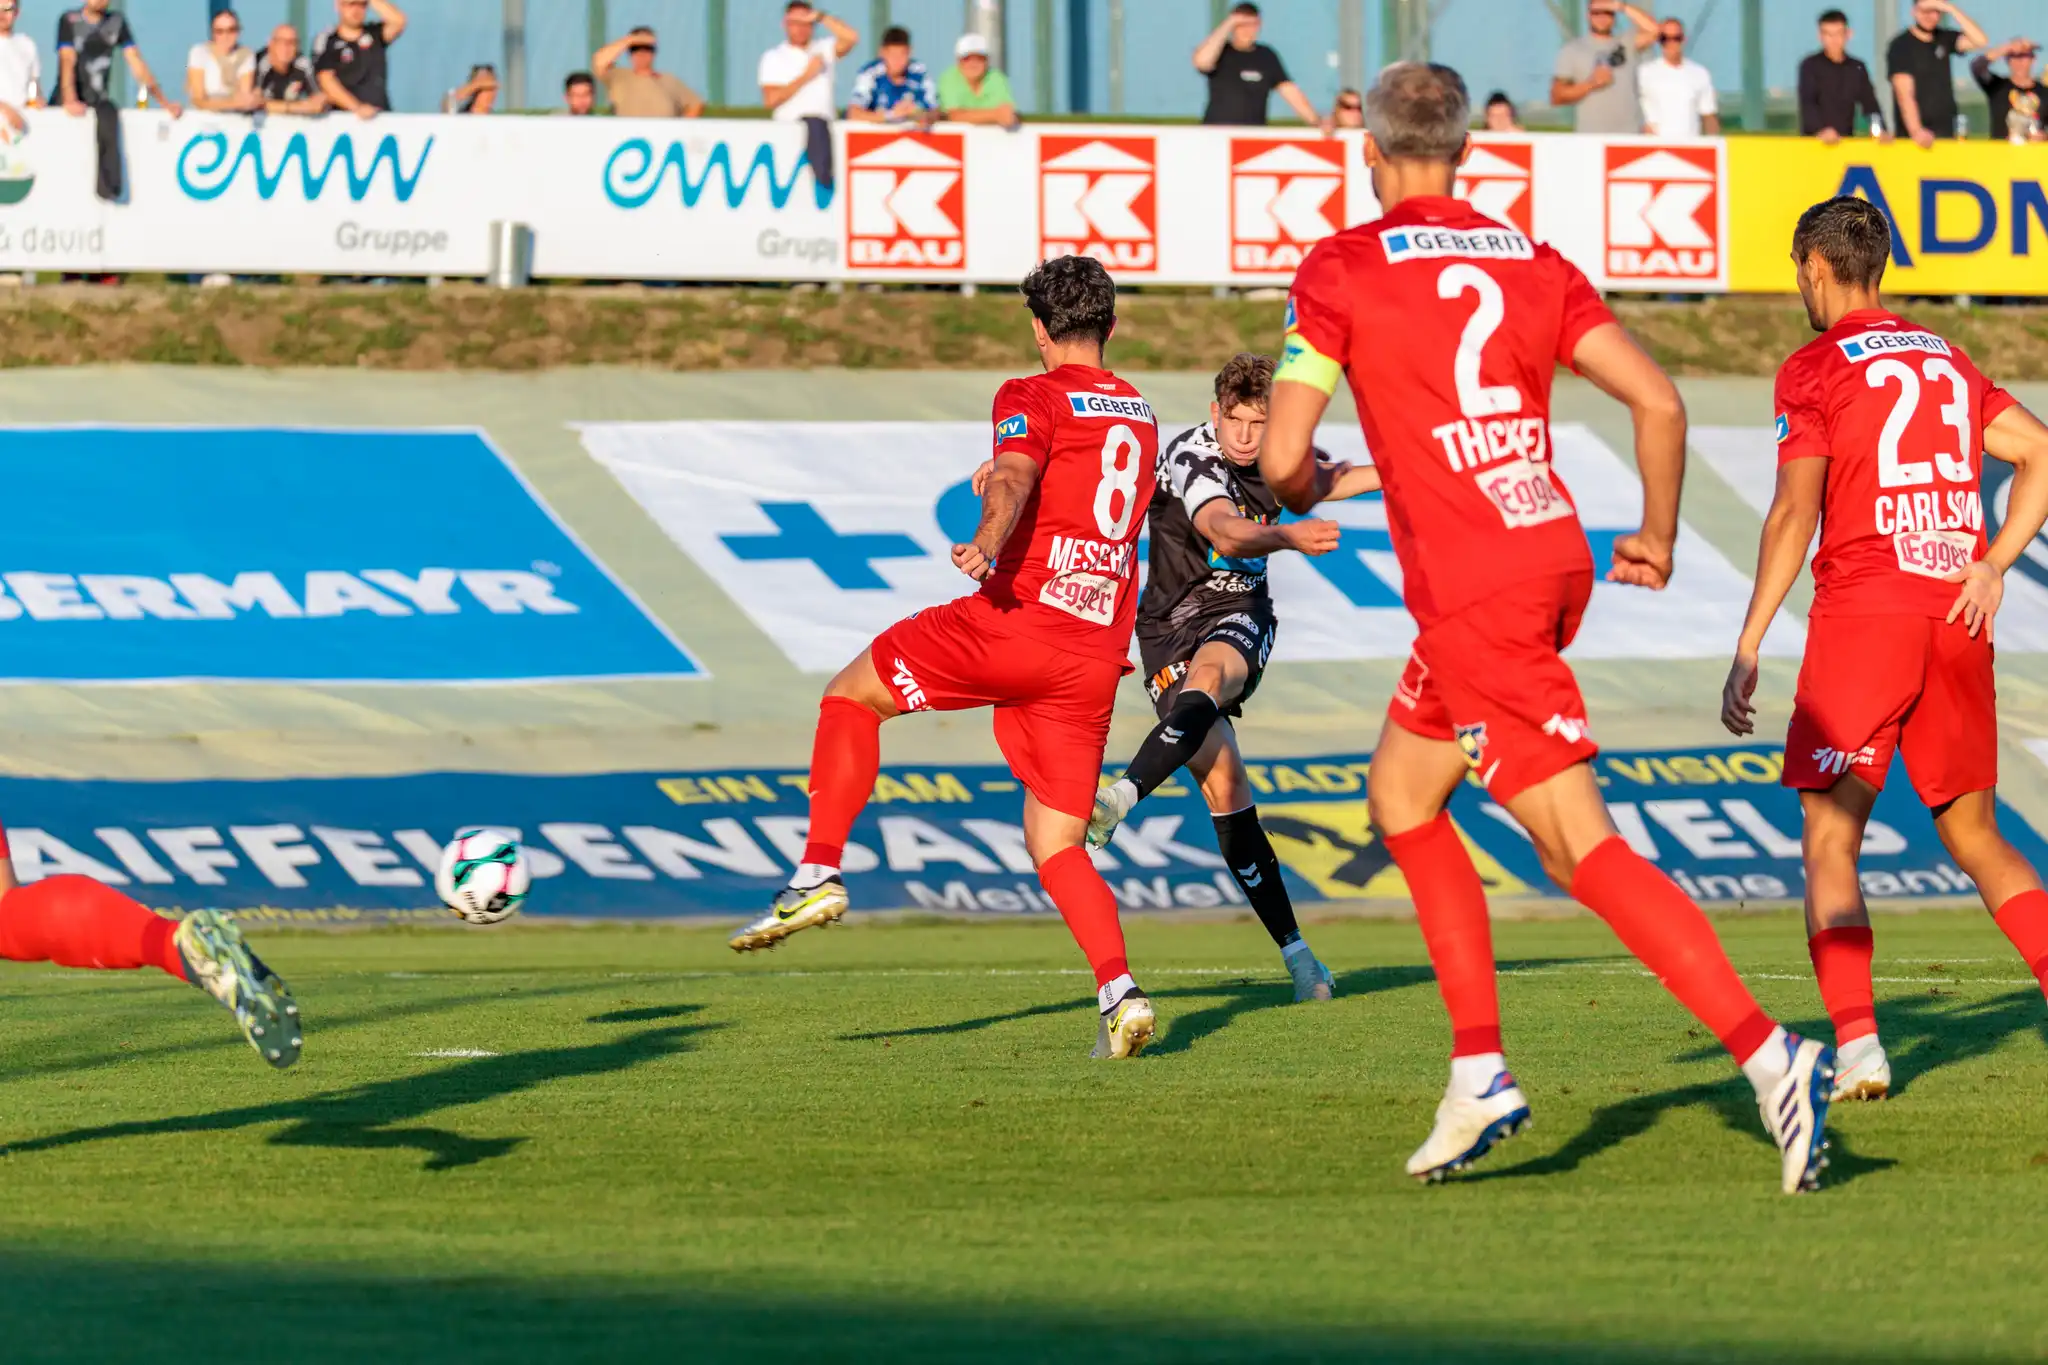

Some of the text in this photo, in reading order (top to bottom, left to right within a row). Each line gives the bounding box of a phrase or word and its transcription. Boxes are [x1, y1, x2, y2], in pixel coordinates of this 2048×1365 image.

[22, 227, 104, 254] david
[335, 221, 449, 257] Gruppe
[850, 239, 963, 265] BAU
[1413, 232, 1527, 252] GEBERIT
[1233, 244, 1316, 270] BA
[1608, 249, 1715, 276] BAU
[1436, 263, 1523, 418] 2
[1864, 335, 1947, 352] GEBERIT
[1865, 357, 1974, 488] 23
[1093, 424, 1142, 541] 8
[656, 776, 778, 806] EIN
[1606, 750, 1787, 785] VISIO
[1106, 871, 1246, 910] Wel
